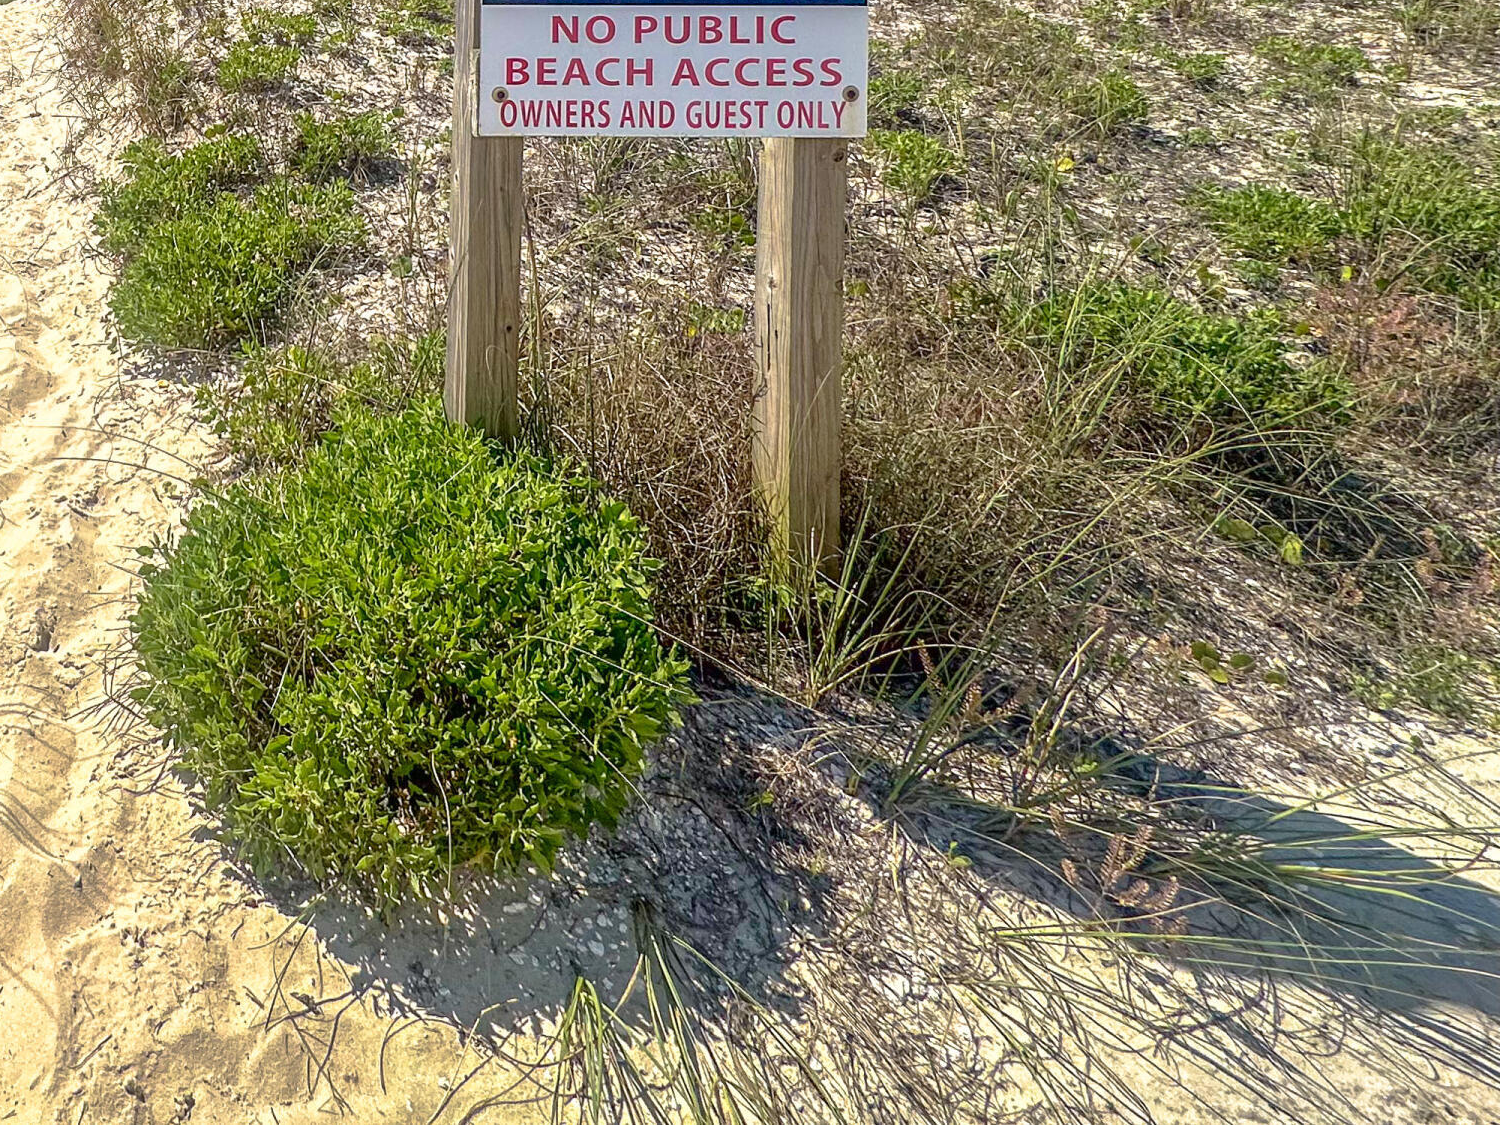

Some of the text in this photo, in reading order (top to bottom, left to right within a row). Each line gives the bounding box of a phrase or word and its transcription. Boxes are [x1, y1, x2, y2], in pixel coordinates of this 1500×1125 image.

[551, 14, 797, 45] NO PUBLIC
[505, 57, 843, 87] BEACH ACCESS
[500, 99, 847, 129] OWNERS AND GUEST ONLY
